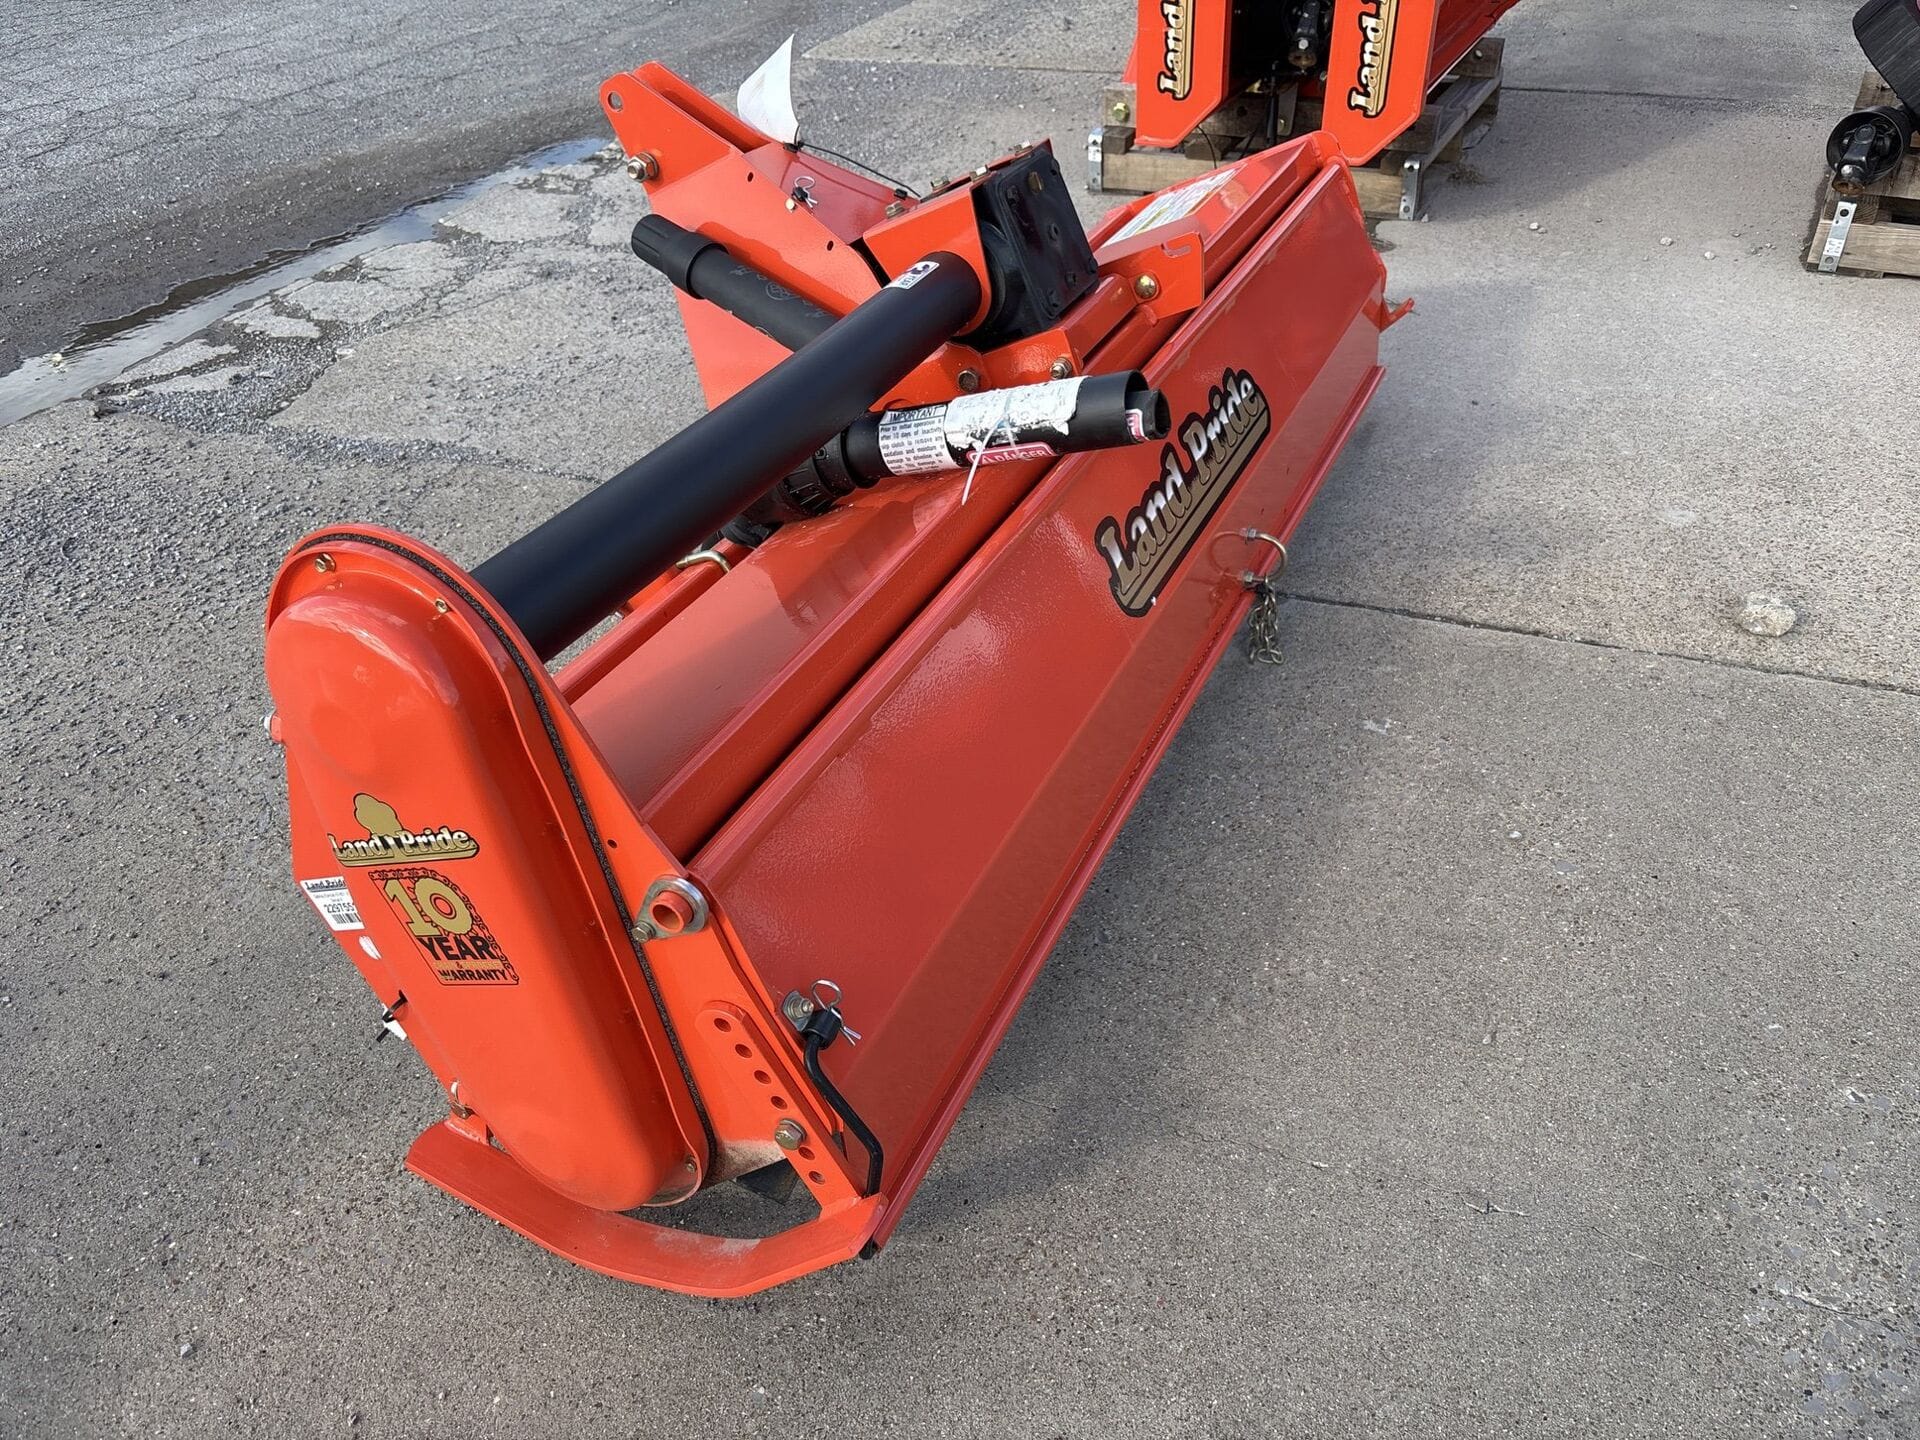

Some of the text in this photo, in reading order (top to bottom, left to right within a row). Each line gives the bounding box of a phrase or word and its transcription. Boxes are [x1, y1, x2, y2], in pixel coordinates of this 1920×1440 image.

[1159, 2, 1184, 96] Land
[1350, 14, 1385, 113] Land
[889, 407, 939, 421] IMPORTANT
[993, 449, 1047, 462] DANGER
[1099, 374, 1261, 596] Land Pride
[328, 826, 471, 858] Land Pride
[383, 876, 474, 937] 10
[419, 936, 499, 960] YEAR
[438, 969, 508, 981] WARRANTY
